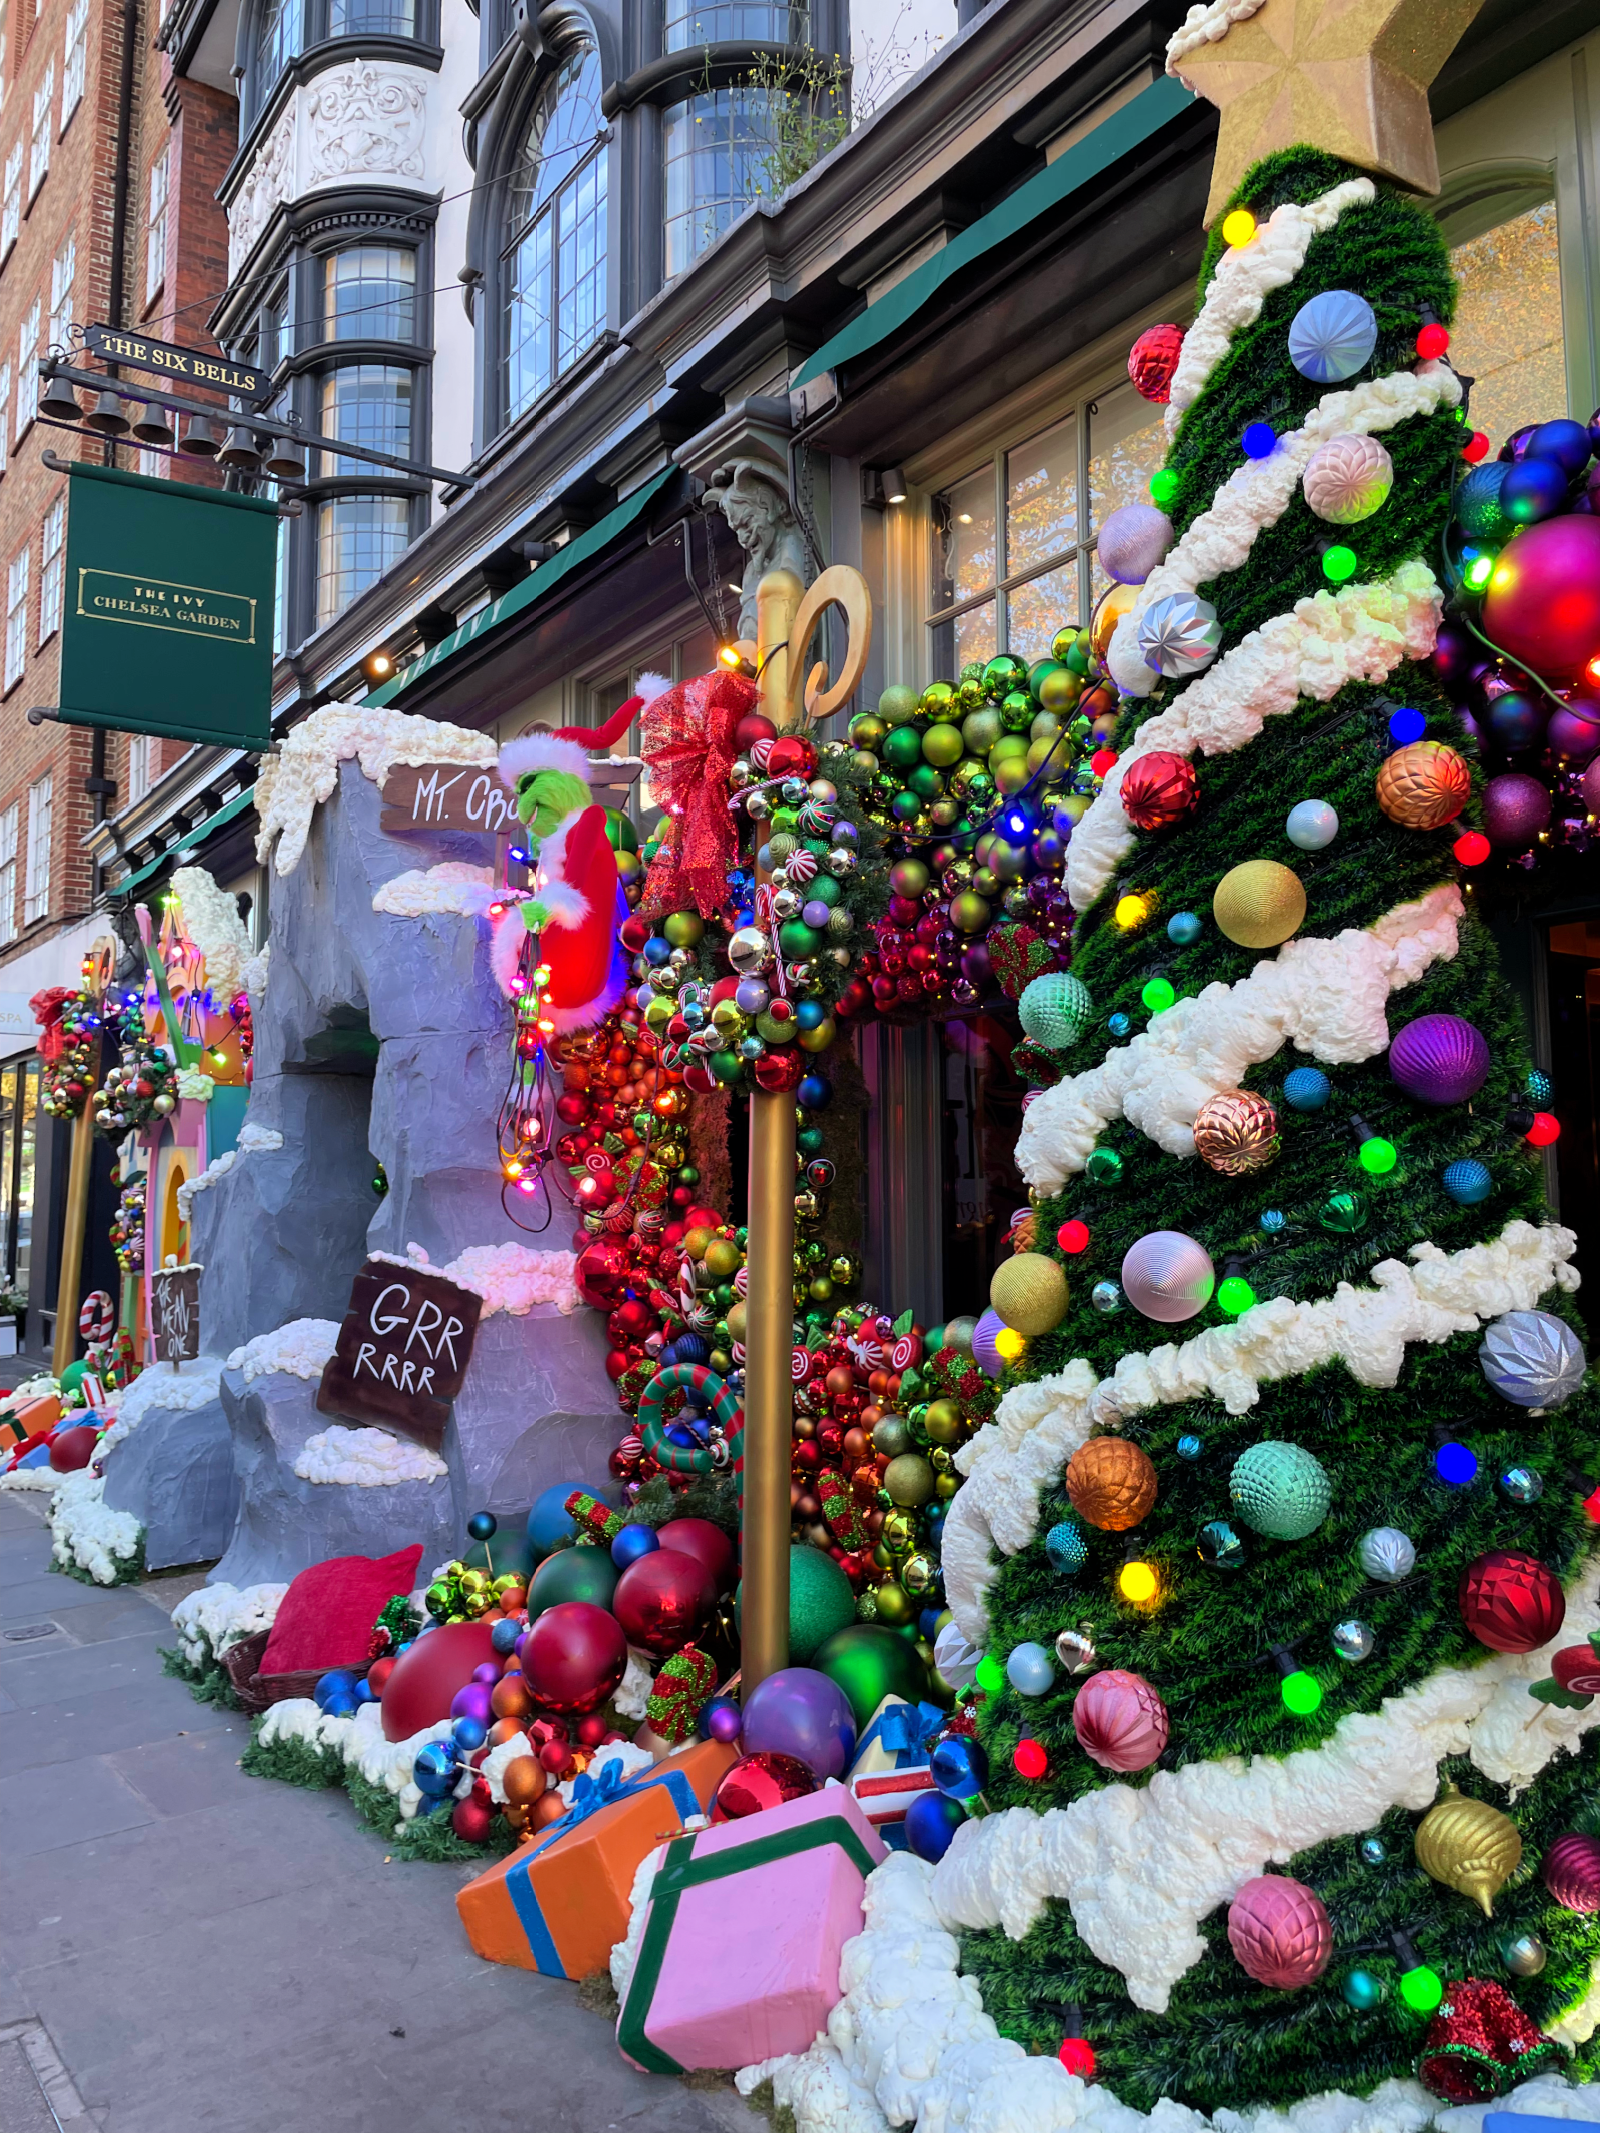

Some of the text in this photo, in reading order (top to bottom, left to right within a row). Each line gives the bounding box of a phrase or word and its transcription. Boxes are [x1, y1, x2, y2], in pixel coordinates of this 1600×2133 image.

[101, 334, 255, 391] THE SIX BELLS
[93, 595, 240, 630] CHELSEA GARDEN
[134, 587, 205, 608] THE IVY
[452, 593, 508, 649] IVY
[0, 1012, 22, 1024] SPA
[156, 1277, 173, 1308] THE
[161, 1288, 190, 1338] MEAN
[168, 1334, 191, 1358] ONE
[370, 1283, 464, 1372] GRR
[352, 1342, 436, 1395] RRRR
